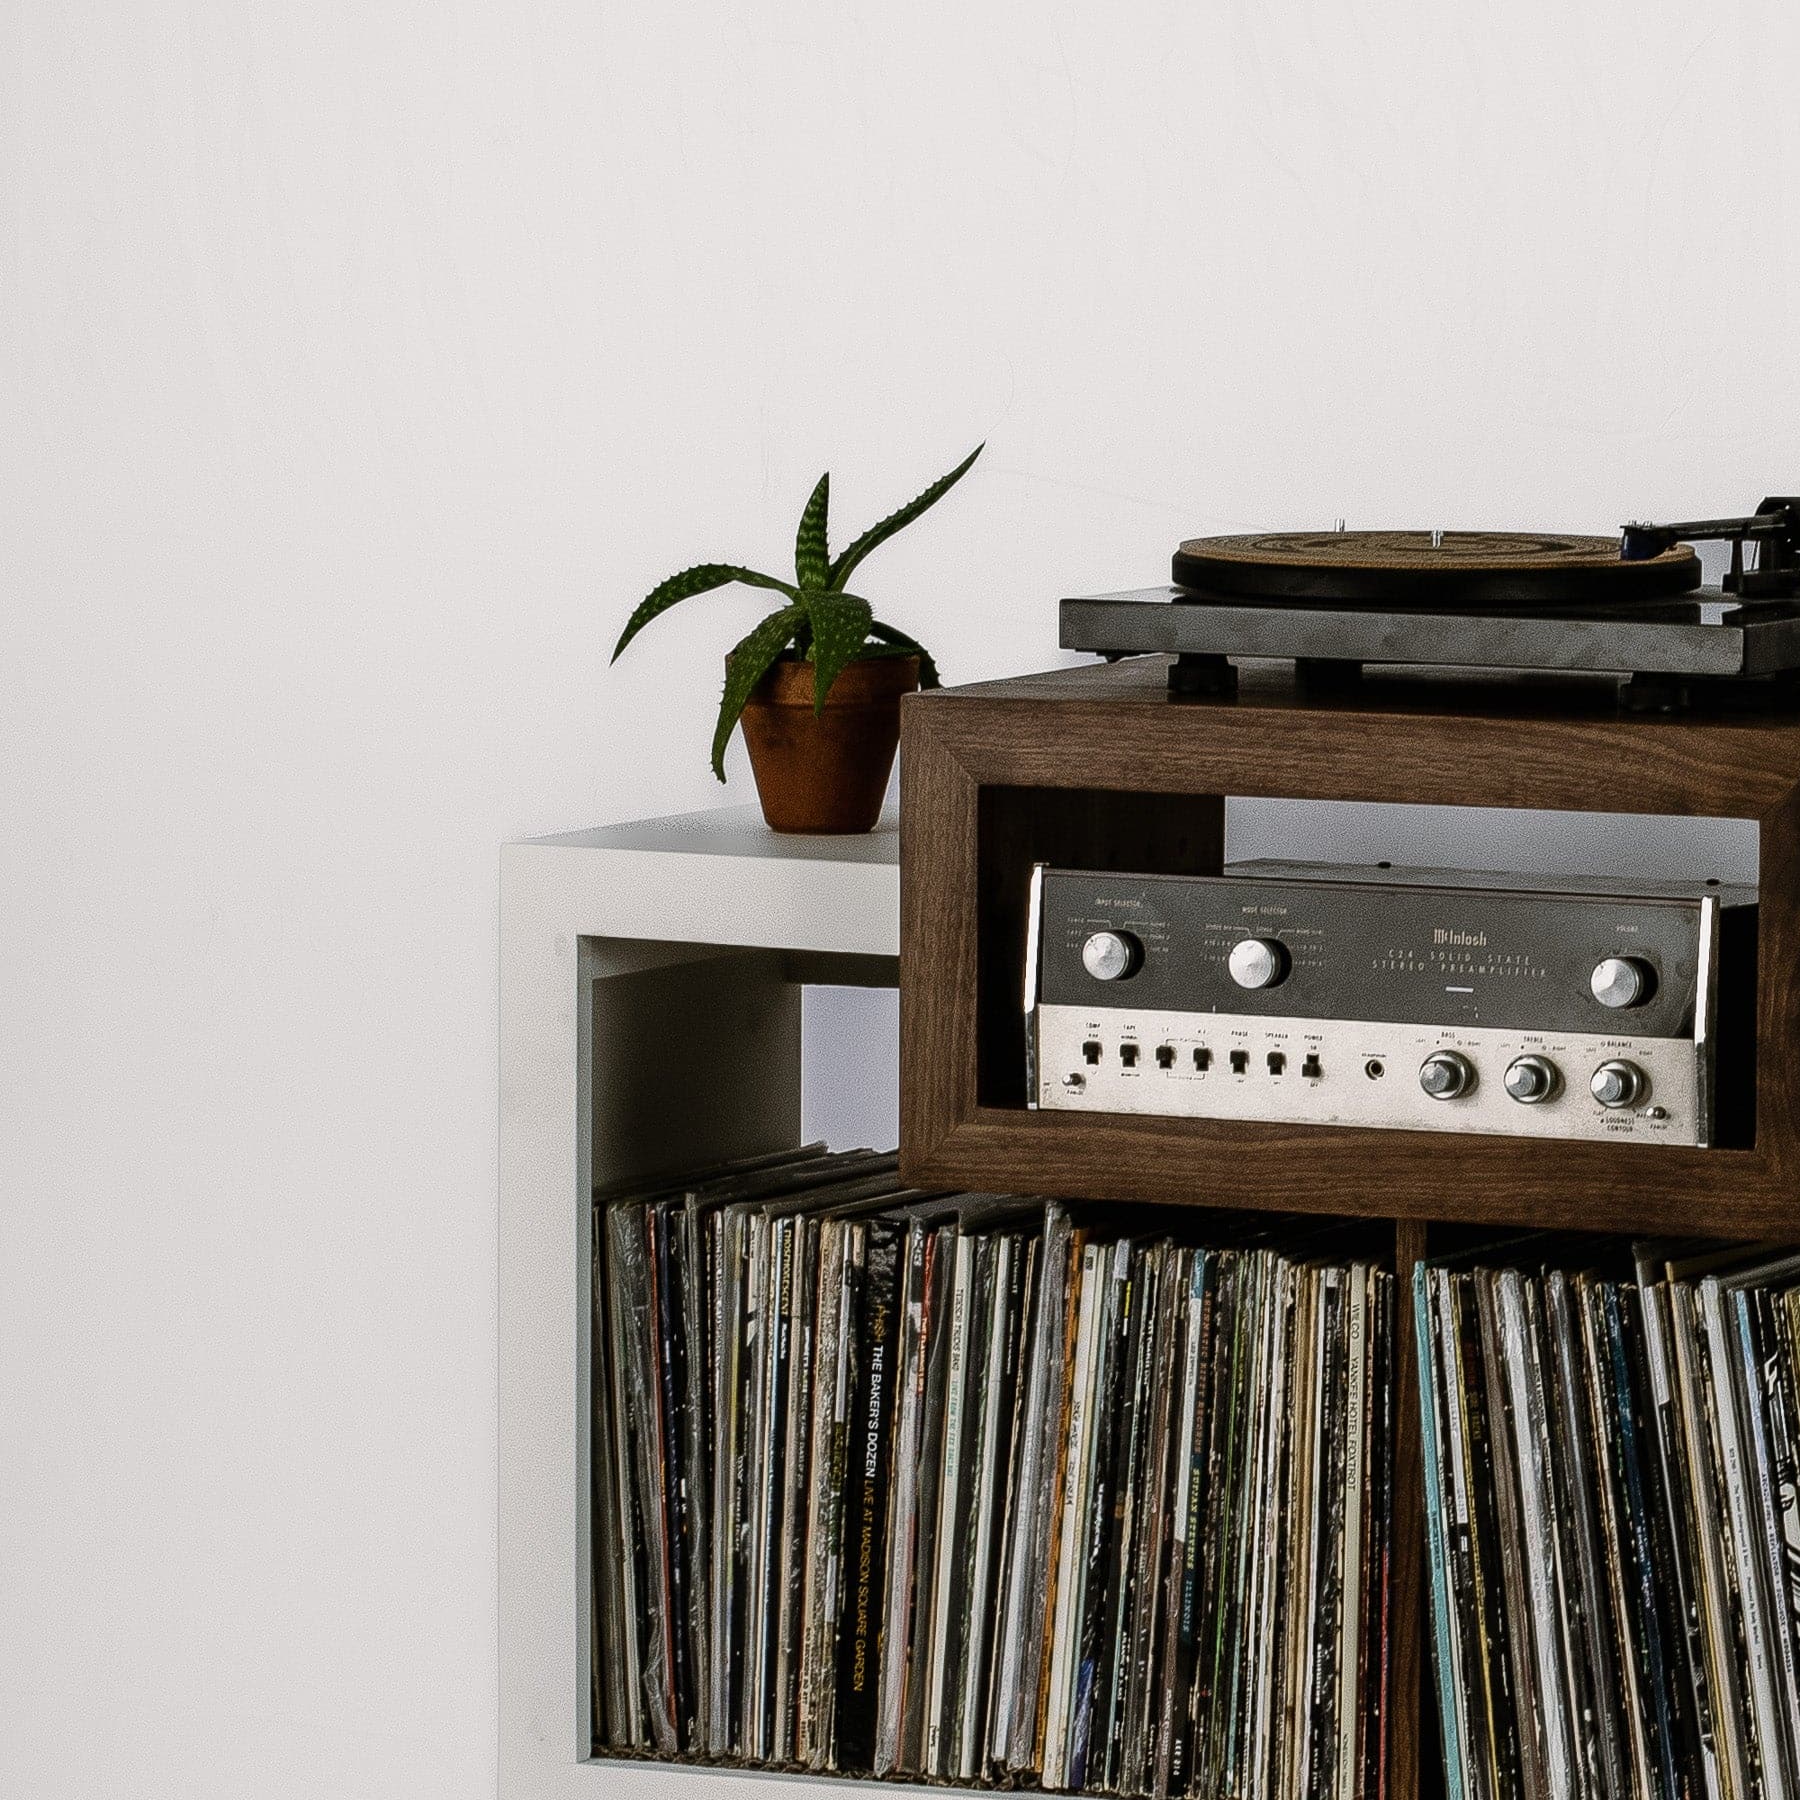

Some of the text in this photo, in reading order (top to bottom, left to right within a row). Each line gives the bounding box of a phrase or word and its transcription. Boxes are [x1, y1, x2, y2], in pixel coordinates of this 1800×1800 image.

[1433, 928, 1487, 947] McIntosh
[1372, 960, 1547, 977] STEREO PREAMPLIFIER
[1430, 952, 1472, 962] SOLID
[1487, 954, 1530, 965] STATE
[780, 1228, 792, 1316] PHOSPHORESCENT
[871, 1344, 884, 1371] THE
[951, 1324, 962, 1351] TRUCKS
[950, 1352, 960, 1372] BAND
[1196, 1361, 1208, 1397] KITTY
[867, 1372, 882, 1430] BAKER'S
[1346, 1302, 1361, 1492] WILCO YANKEE HOTEL FOXTROT
[1192, 1399, 1205, 1454] RECORDS
[864, 1431, 878, 1478] DOZEN
[862, 1479, 875, 1505] LIVE
[1188, 1467, 1201, 1512] SUFJAN
[1732, 1484, 1741, 1496] The
[862, 1507, 873, 1522] AT
[1735, 1513, 1747, 1548] Underground
[1760, 1472, 1771, 1502] ARCADE
[1768, 1532, 1780, 1577] REFLEKTOR
[858, 1525, 872, 1583] MADISON
[1185, 1515, 1197, 1570] STEVENS
[1181, 1579, 1193, 1632] ILLINOIS
[1744, 1576, 1755, 1602] Produced
[855, 1585, 869, 1636] SQUARE
[852, 1638, 866, 1692] GARDEN
